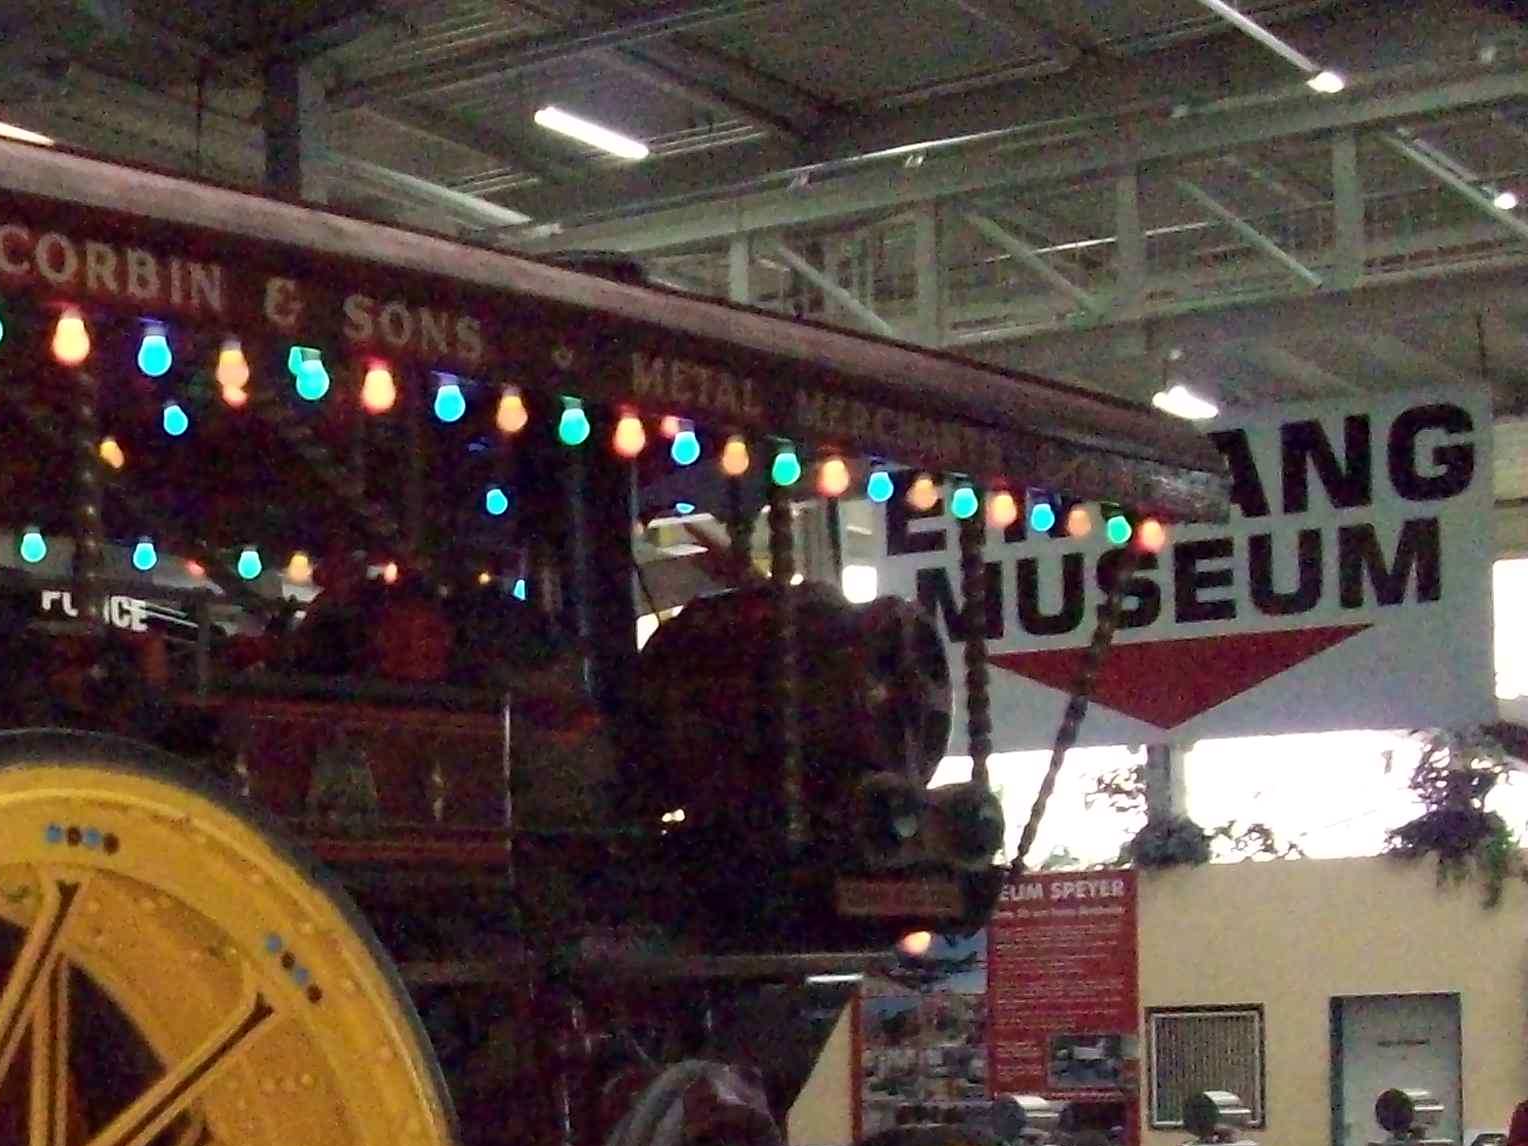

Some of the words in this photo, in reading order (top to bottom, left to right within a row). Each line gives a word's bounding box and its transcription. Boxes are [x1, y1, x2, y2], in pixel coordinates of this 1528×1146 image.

[264, 279, 303, 326] &
[342, 291, 485, 361] SONS
[631, 351, 763, 417] METAL
[916, 517, 1442, 643] MUSEUM
[1050, 879, 1126, 899] SPEYER
